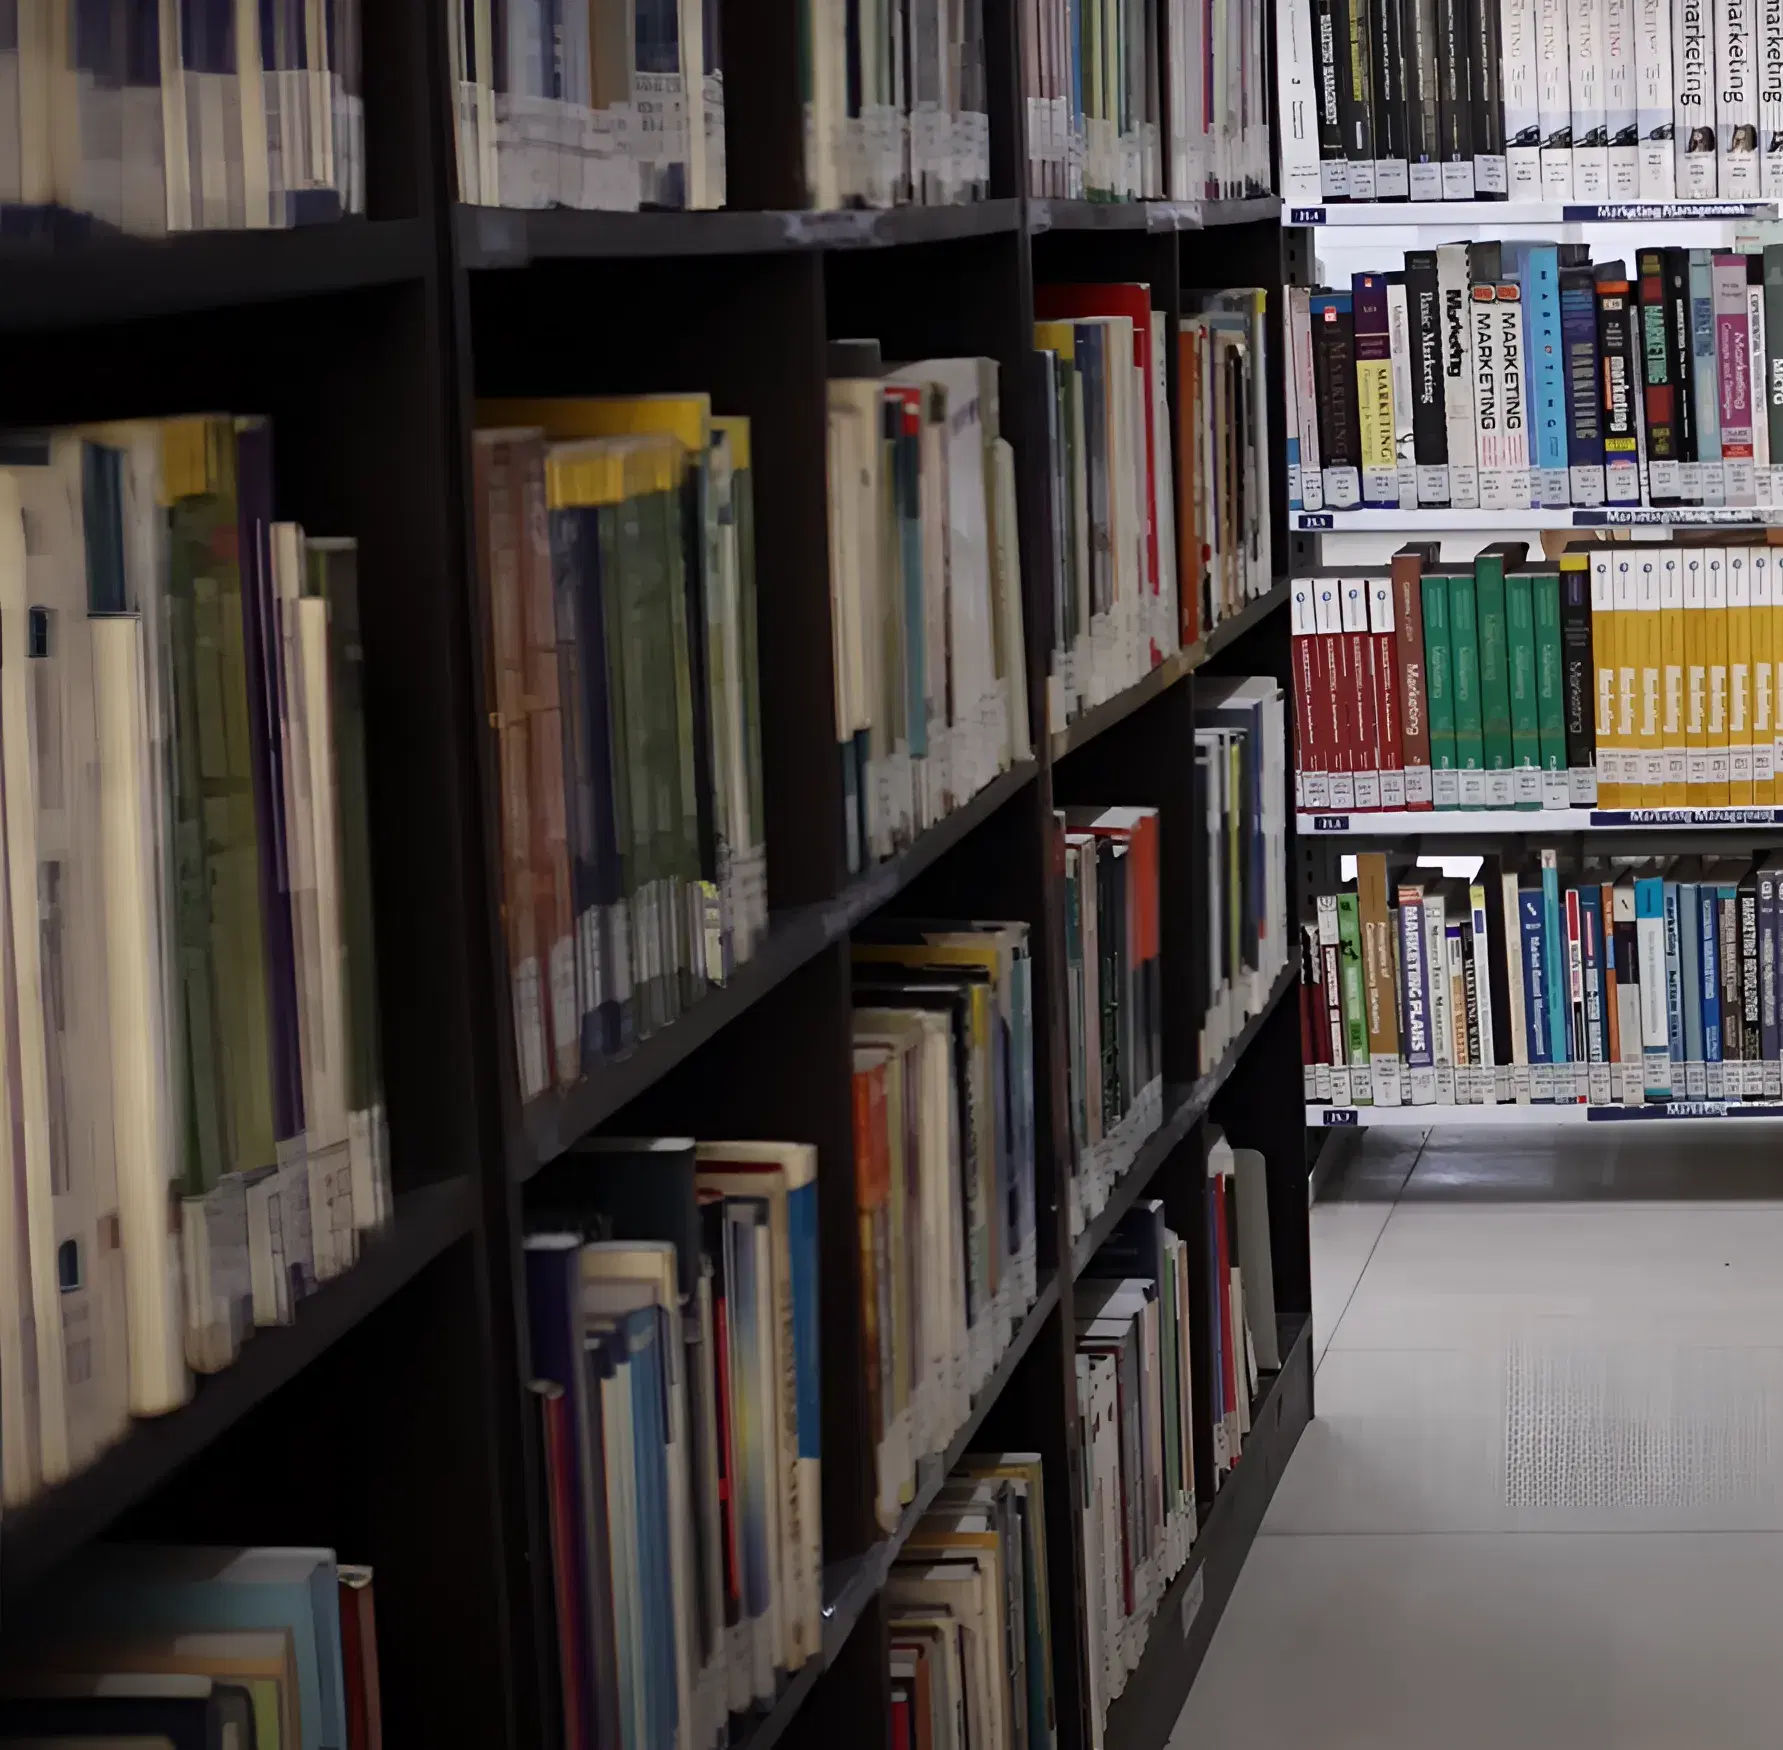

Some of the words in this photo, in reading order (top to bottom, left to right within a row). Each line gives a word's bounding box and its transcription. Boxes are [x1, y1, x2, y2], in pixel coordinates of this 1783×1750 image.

[1597, 206, 1661, 218] Marketing
[1420, 292, 1433, 328] Basic
[1446, 289, 1468, 377] Marketing
[1421, 332, 1437, 404] Marketing
[1477, 313, 1495, 430] MARKETING
[1502, 313, 1520, 430] MARKETING
[1377, 368, 1390, 459] MARKETING
[1405, 663, 1420, 735] Marketing
[1405, 906, 1423, 998] MARKETING
[1409, 1000, 1425, 1051] PLANS
